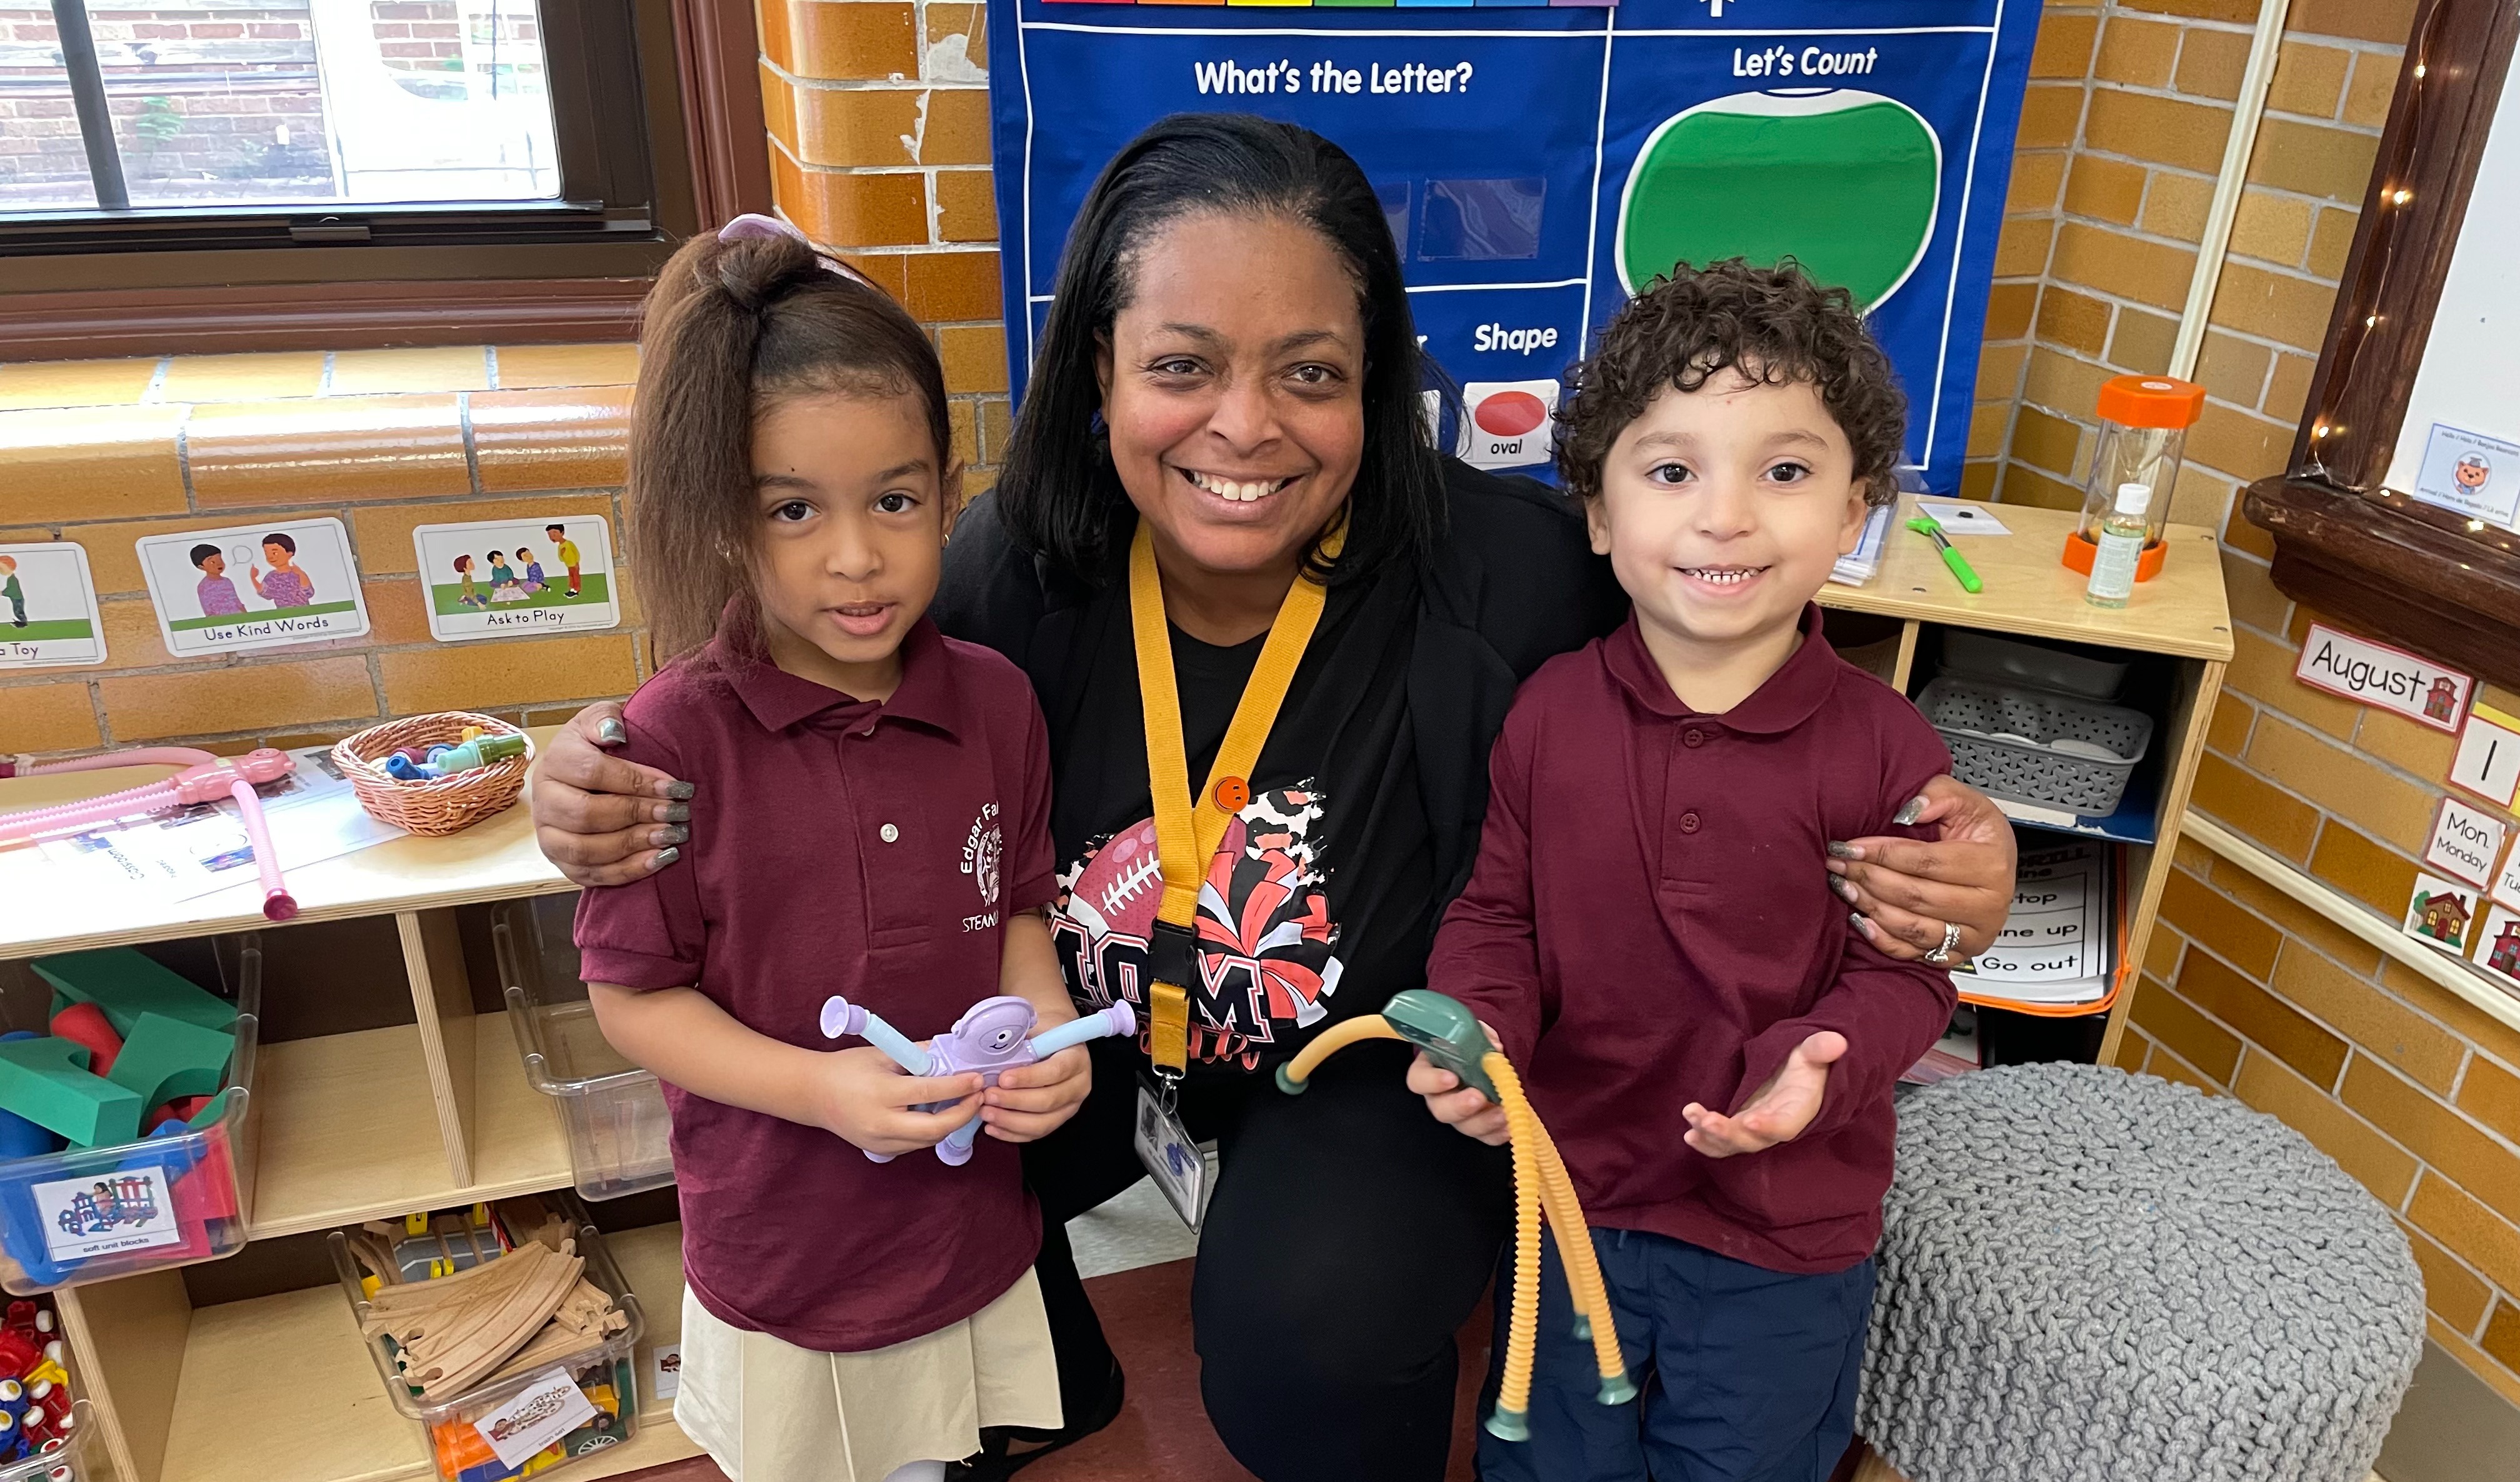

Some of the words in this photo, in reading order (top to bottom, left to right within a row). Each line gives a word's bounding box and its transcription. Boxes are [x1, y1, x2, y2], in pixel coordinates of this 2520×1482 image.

[1733, 45, 1794, 76] Let's
[1801, 46, 1878, 76] Count
[1194, 59, 1300, 94] What's
[1310, 60, 1362, 94] the
[1371, 61, 1473, 94] Letter?
[1474, 323, 1558, 356] Shape
[1491, 439, 1522, 454] oval
[204, 628, 232, 640] Use
[236, 622, 271, 637] Kind
[275, 616, 329, 632] Words
[488, 613, 511, 625] Ask
[516, 614, 528, 623] to
[534, 610, 564, 624] Play
[9, 643, 39, 659] Toy
[2312, 640, 2426, 701] August
[2447, 812, 2489, 849] Mon.
[961, 816, 982, 873] Edgar
[2437, 836, 2487, 873] Monday
[2011, 893, 2057, 904] top
[2047, 925, 2078, 936] up
[1982, 957, 2018, 971] Go
[2031, 956, 2078, 971] out
[121, 1238, 149, 1246] blocks
